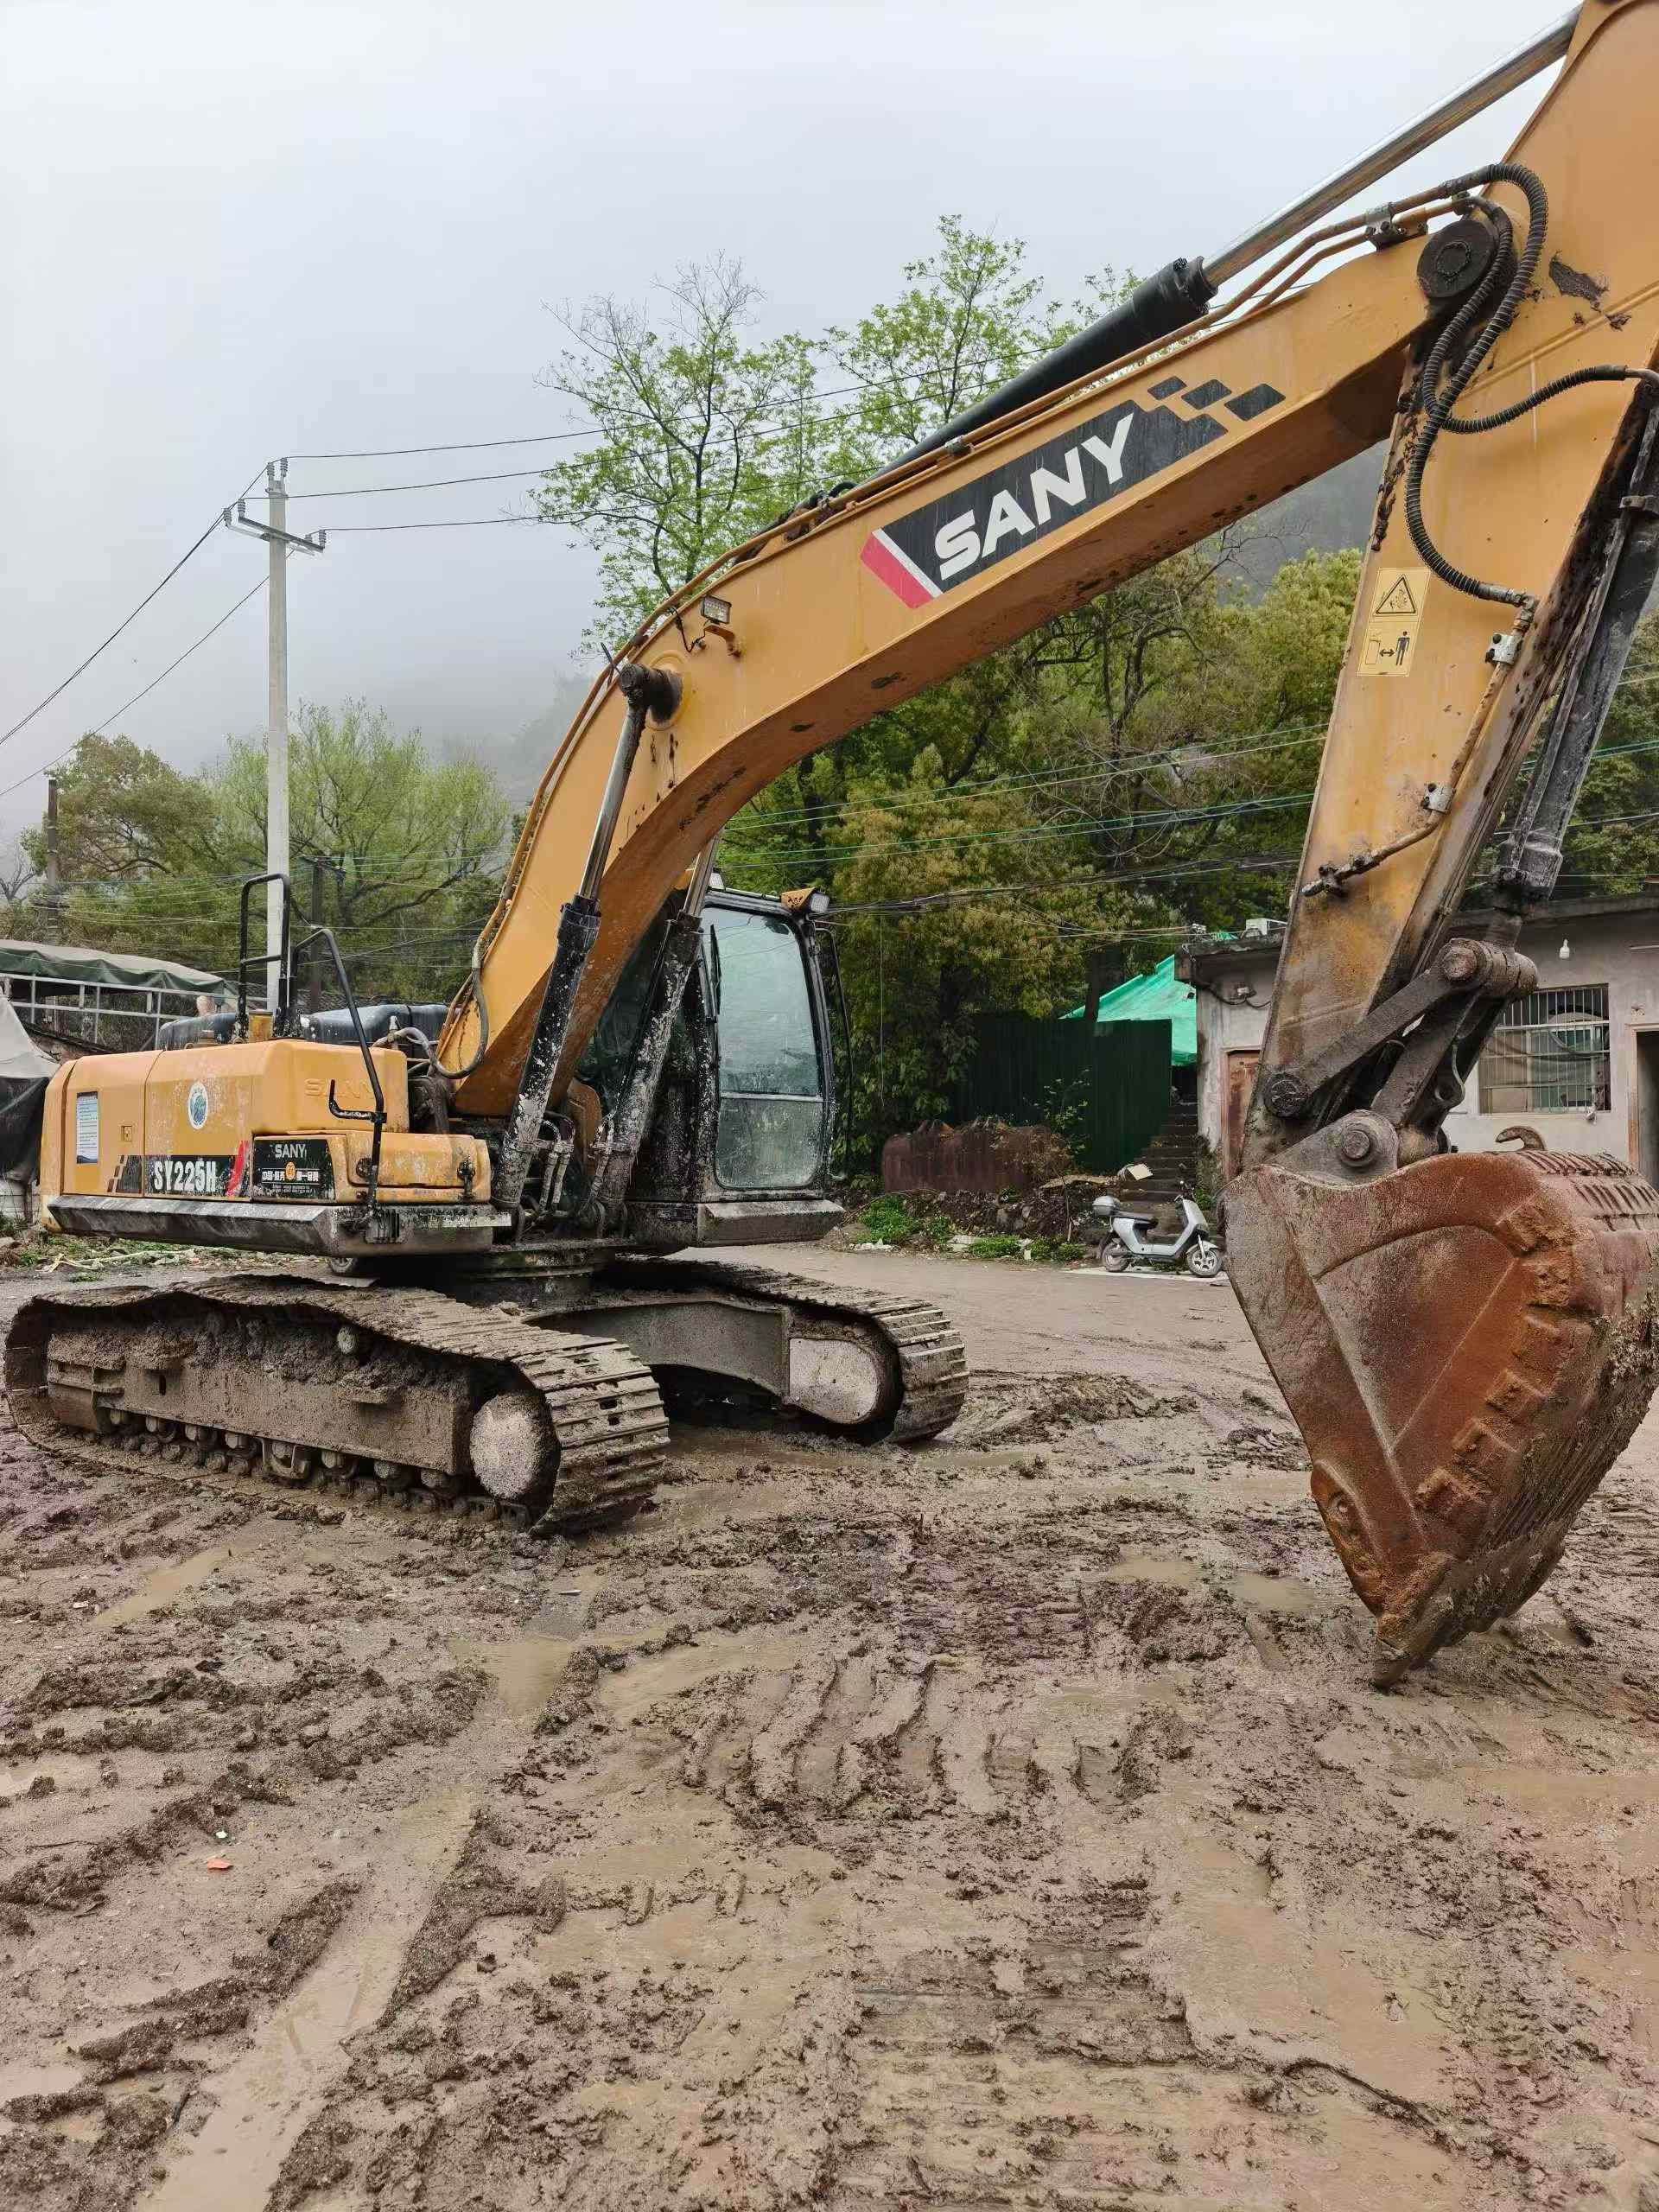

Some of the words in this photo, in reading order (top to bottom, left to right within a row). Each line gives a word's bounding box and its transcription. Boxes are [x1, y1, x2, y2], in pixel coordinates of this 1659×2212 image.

[935, 412, 1134, 581] SANY
[275, 1144, 305, 1158] SANY
[154, 1160, 216, 1192] SY225H
